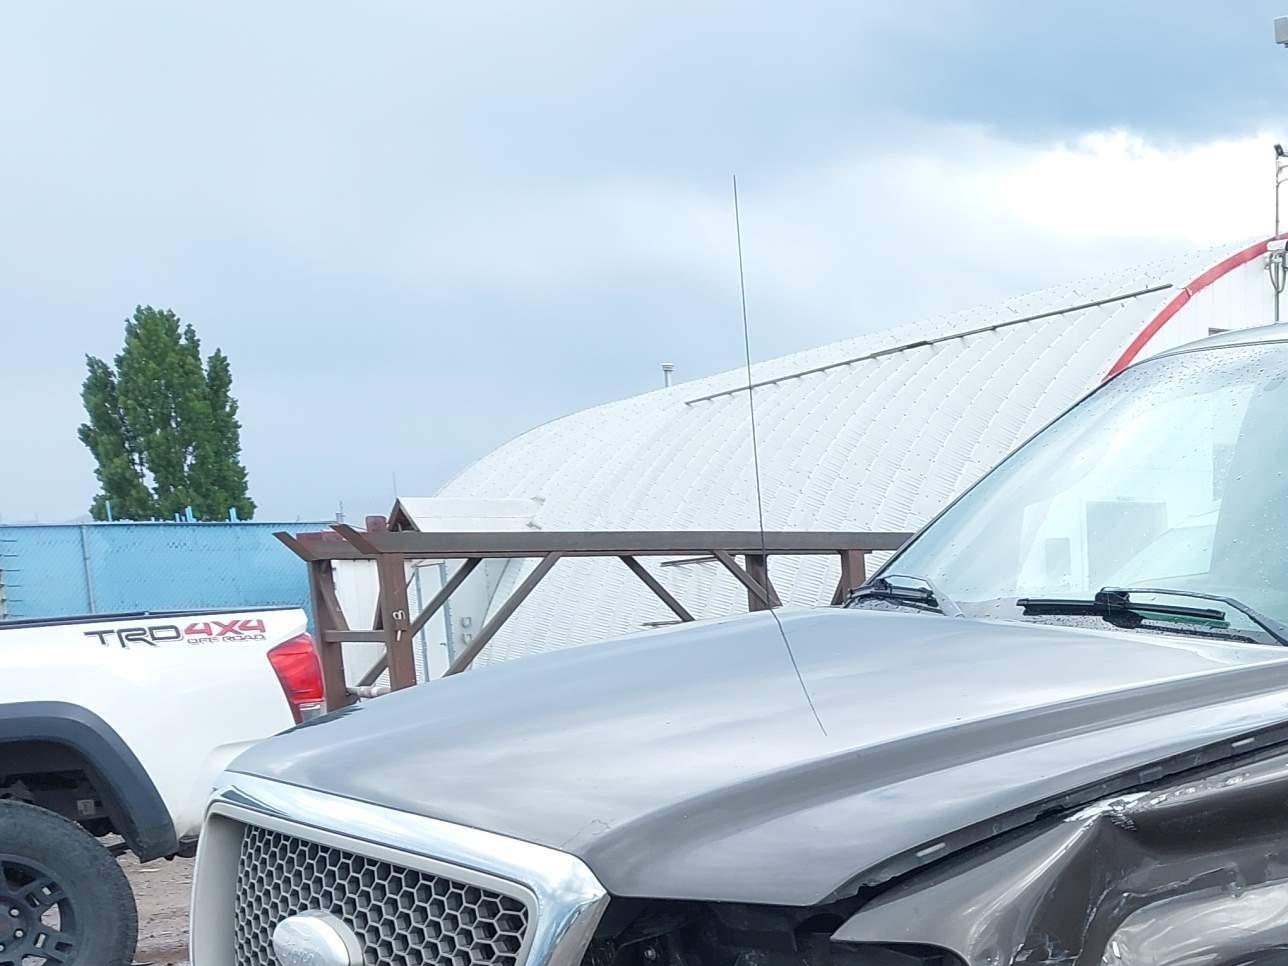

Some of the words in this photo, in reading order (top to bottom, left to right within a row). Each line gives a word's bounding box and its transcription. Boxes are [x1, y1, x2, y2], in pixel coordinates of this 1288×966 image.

[84, 625, 183, 648] TRD
[188, 636, 218, 645] OFF
[222, 634, 266, 643] ROAD
